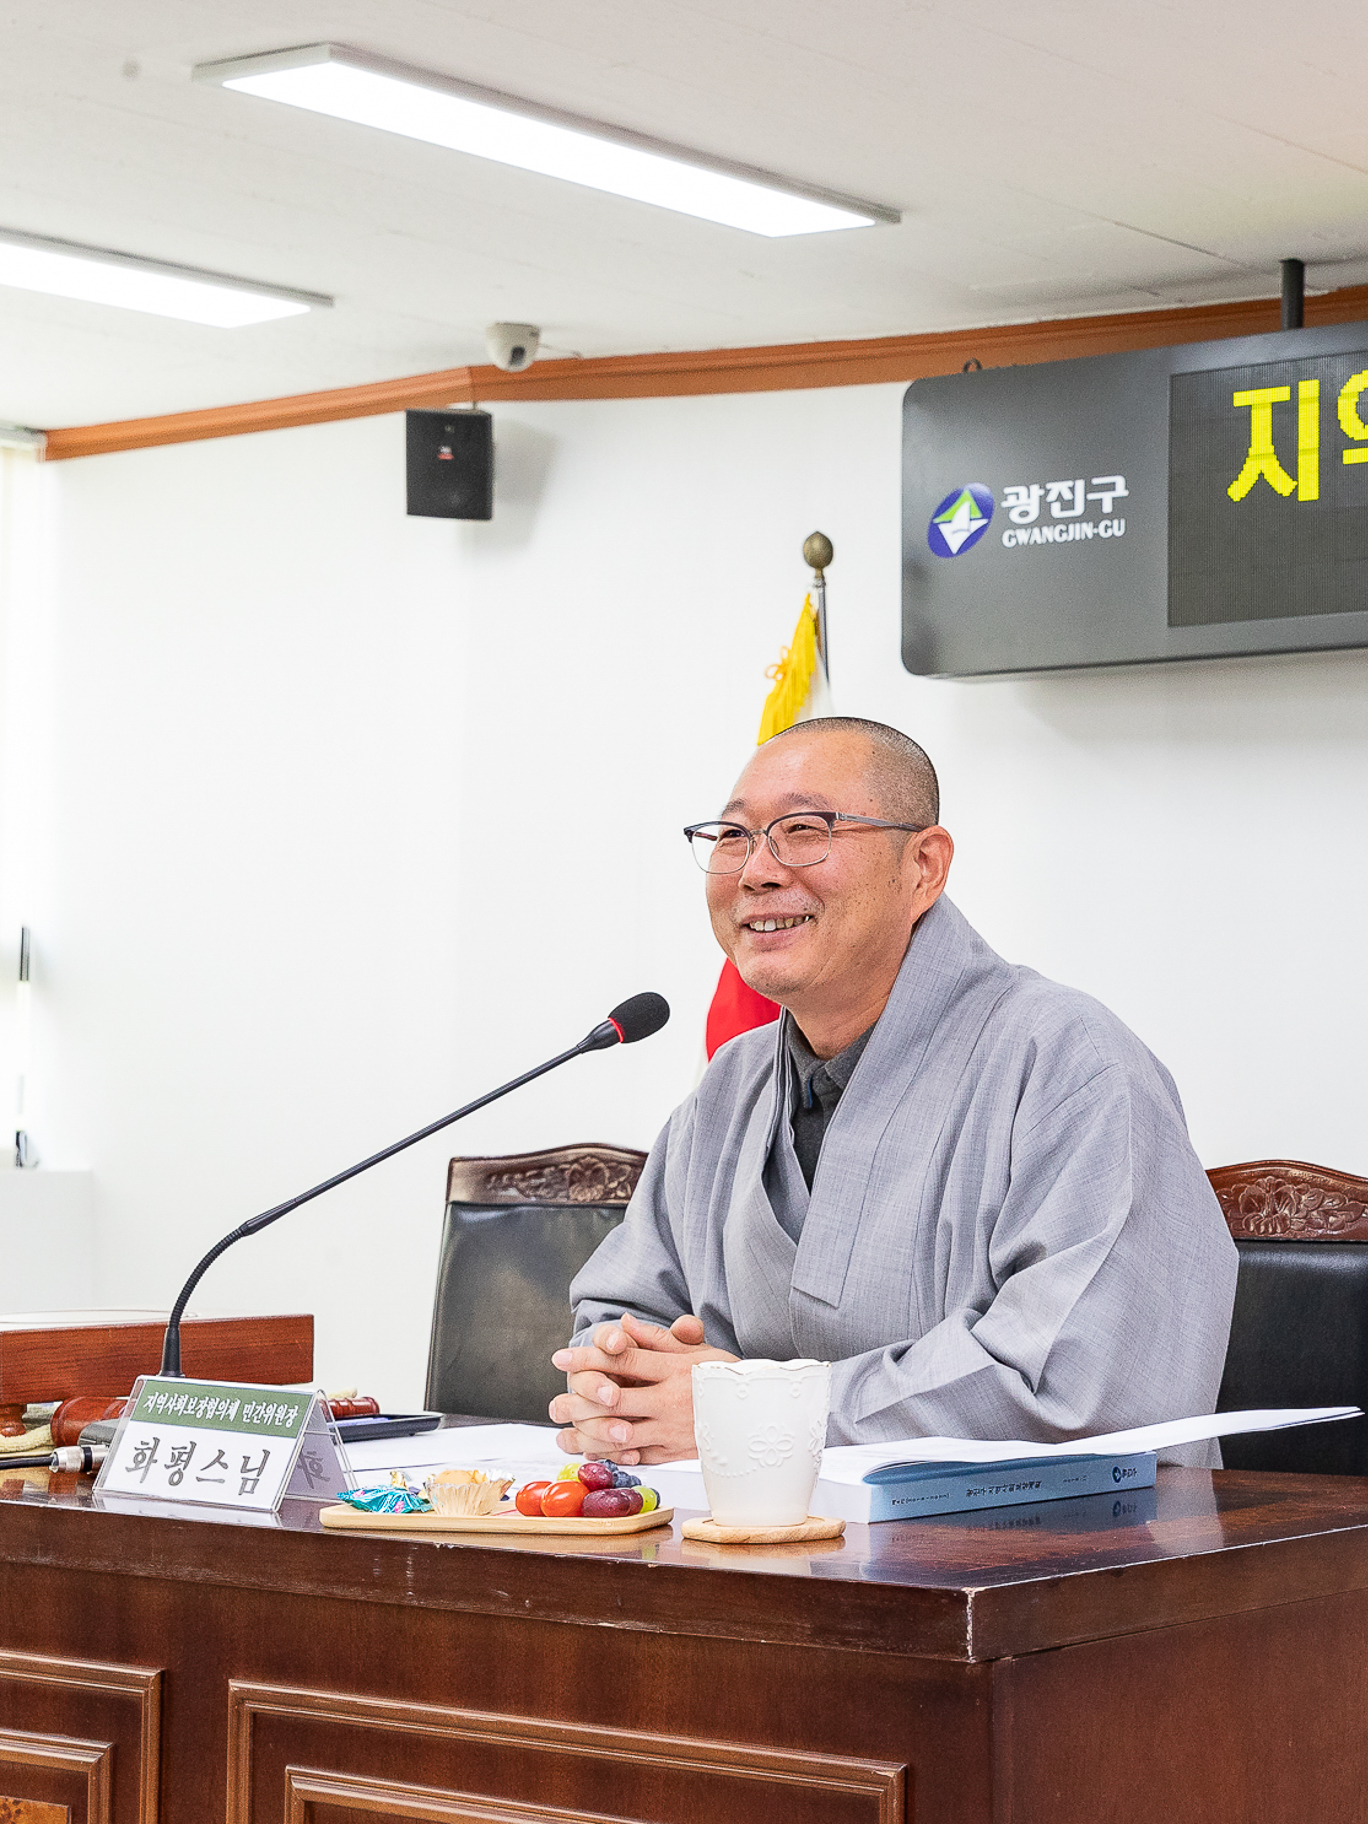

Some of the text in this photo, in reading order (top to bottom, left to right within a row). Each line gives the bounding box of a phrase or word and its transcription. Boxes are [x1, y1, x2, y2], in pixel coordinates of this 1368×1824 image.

[1000, 474, 1130, 525] 광진구
[1000, 517, 1128, 549] GWANGJIN-GU
[143, 1391, 299, 1429] 지역사회보장협의체 민간위원장
[124, 1436, 272, 1496] 화평스님
